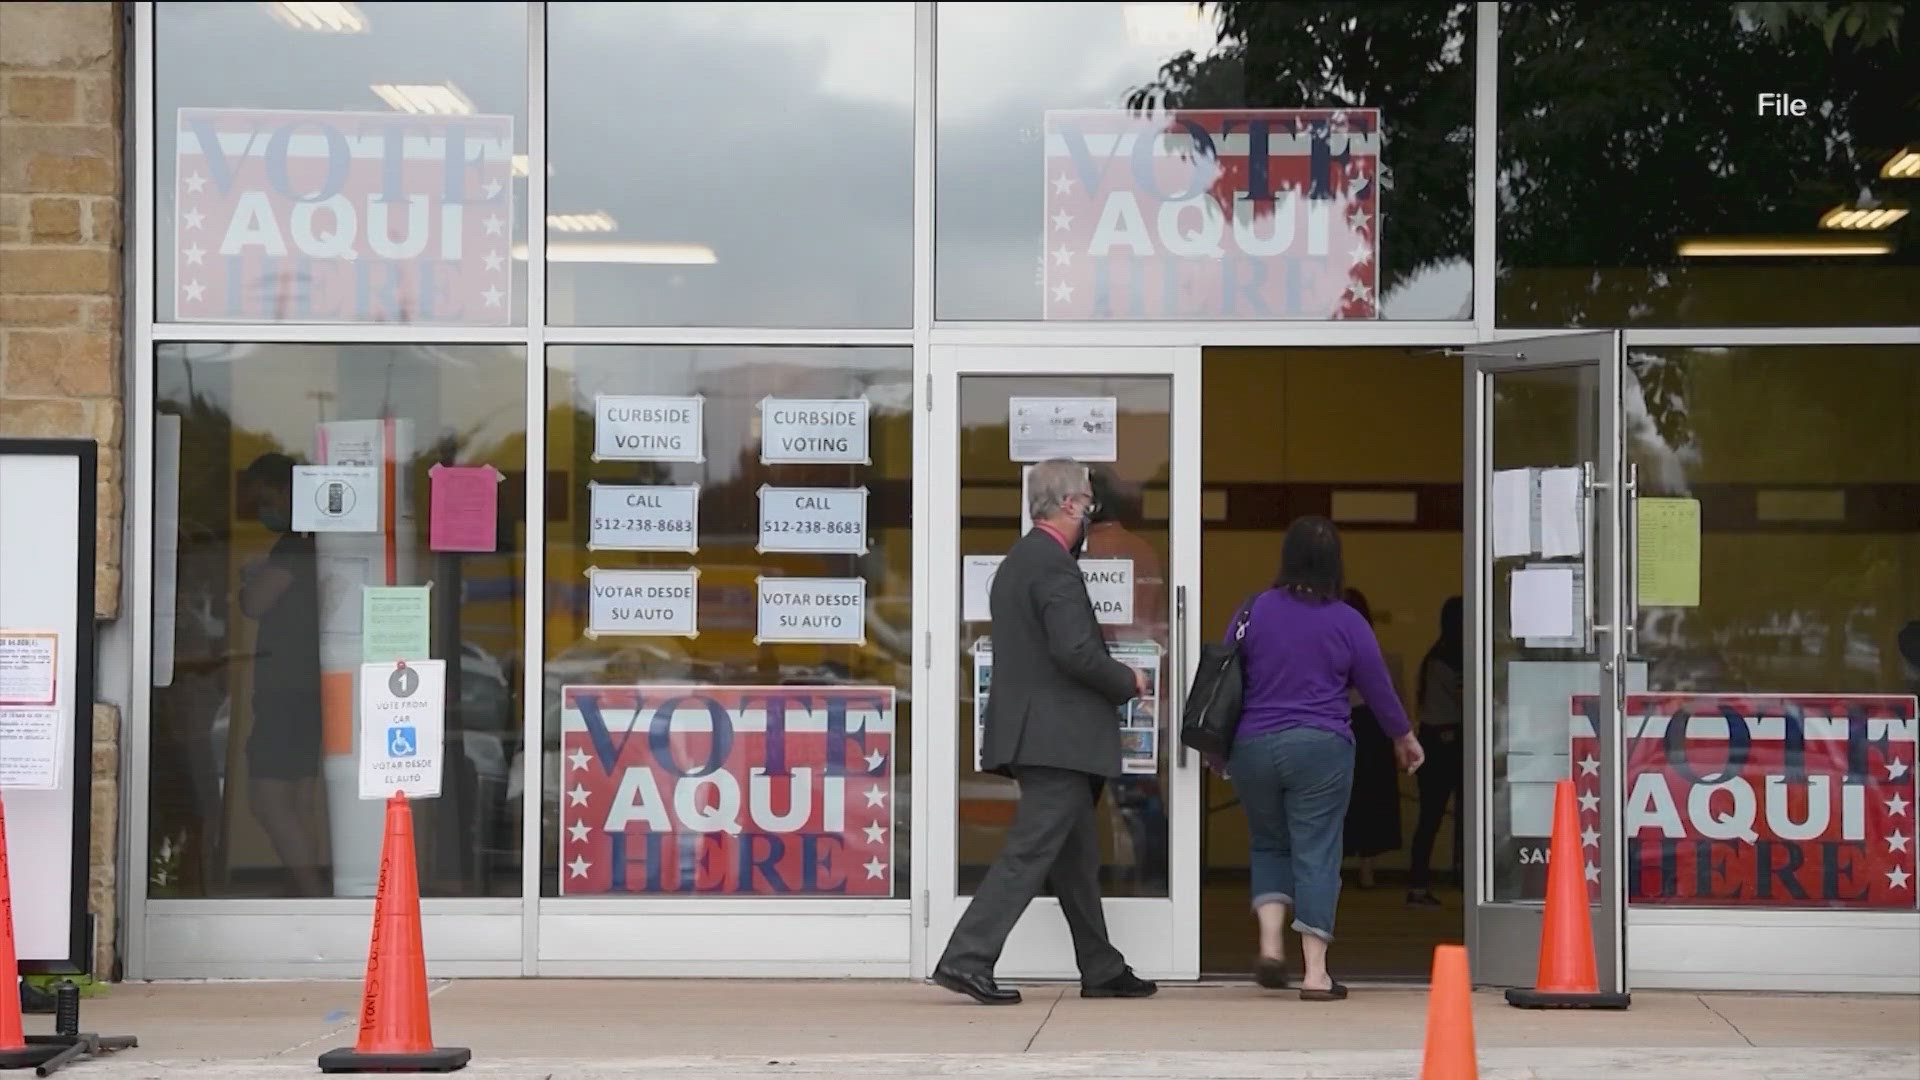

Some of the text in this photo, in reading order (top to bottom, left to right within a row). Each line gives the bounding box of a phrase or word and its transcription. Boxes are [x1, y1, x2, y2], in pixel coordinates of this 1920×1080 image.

[189, 117, 508, 204] VOTE
[1053, 118, 1372, 202] VOTE
[219, 190, 463, 263] AQUI
[1088, 190, 1330, 262] AQUI
[224, 256, 468, 322] HERE
[1091, 256, 1330, 319] HERE
[607, 408, 690, 423] CURBSIDE
[774, 411, 857, 426] CURBSIDE
[615, 434, 681, 450] VOTING
[782, 437, 848, 452] VOTING
[626, 495, 662, 508] CALL
[795, 497, 831, 510] CALL
[595, 519, 692, 532] 512-238-8683
[764, 521, 861, 534] 512-238-8683
[1082, 571, 1126, 584] RANCE
[595, 586, 691, 598] VOTAR DESDE
[763, 593, 859, 606] VOTAR DESDE
[611, 608, 674, 620] SU AUTO
[1094, 601, 1123, 612] ADA
[779, 615, 842, 628] SU AUTO
[398, 673, 408, 692] 1
[376, 701, 428, 710] VOTE FROM
[393, 715, 411, 724] CAR
[571, 695, 888, 778] VOTE
[372, 760, 432, 770] VOTAR DESDE
[385, 774, 421, 784] EL AUTO
[603, 767, 846, 838] AQUI
[1626, 773, 1865, 845] AQUI
[606, 832, 848, 893] HERE
[1628, 839, 1871, 900] HERE
